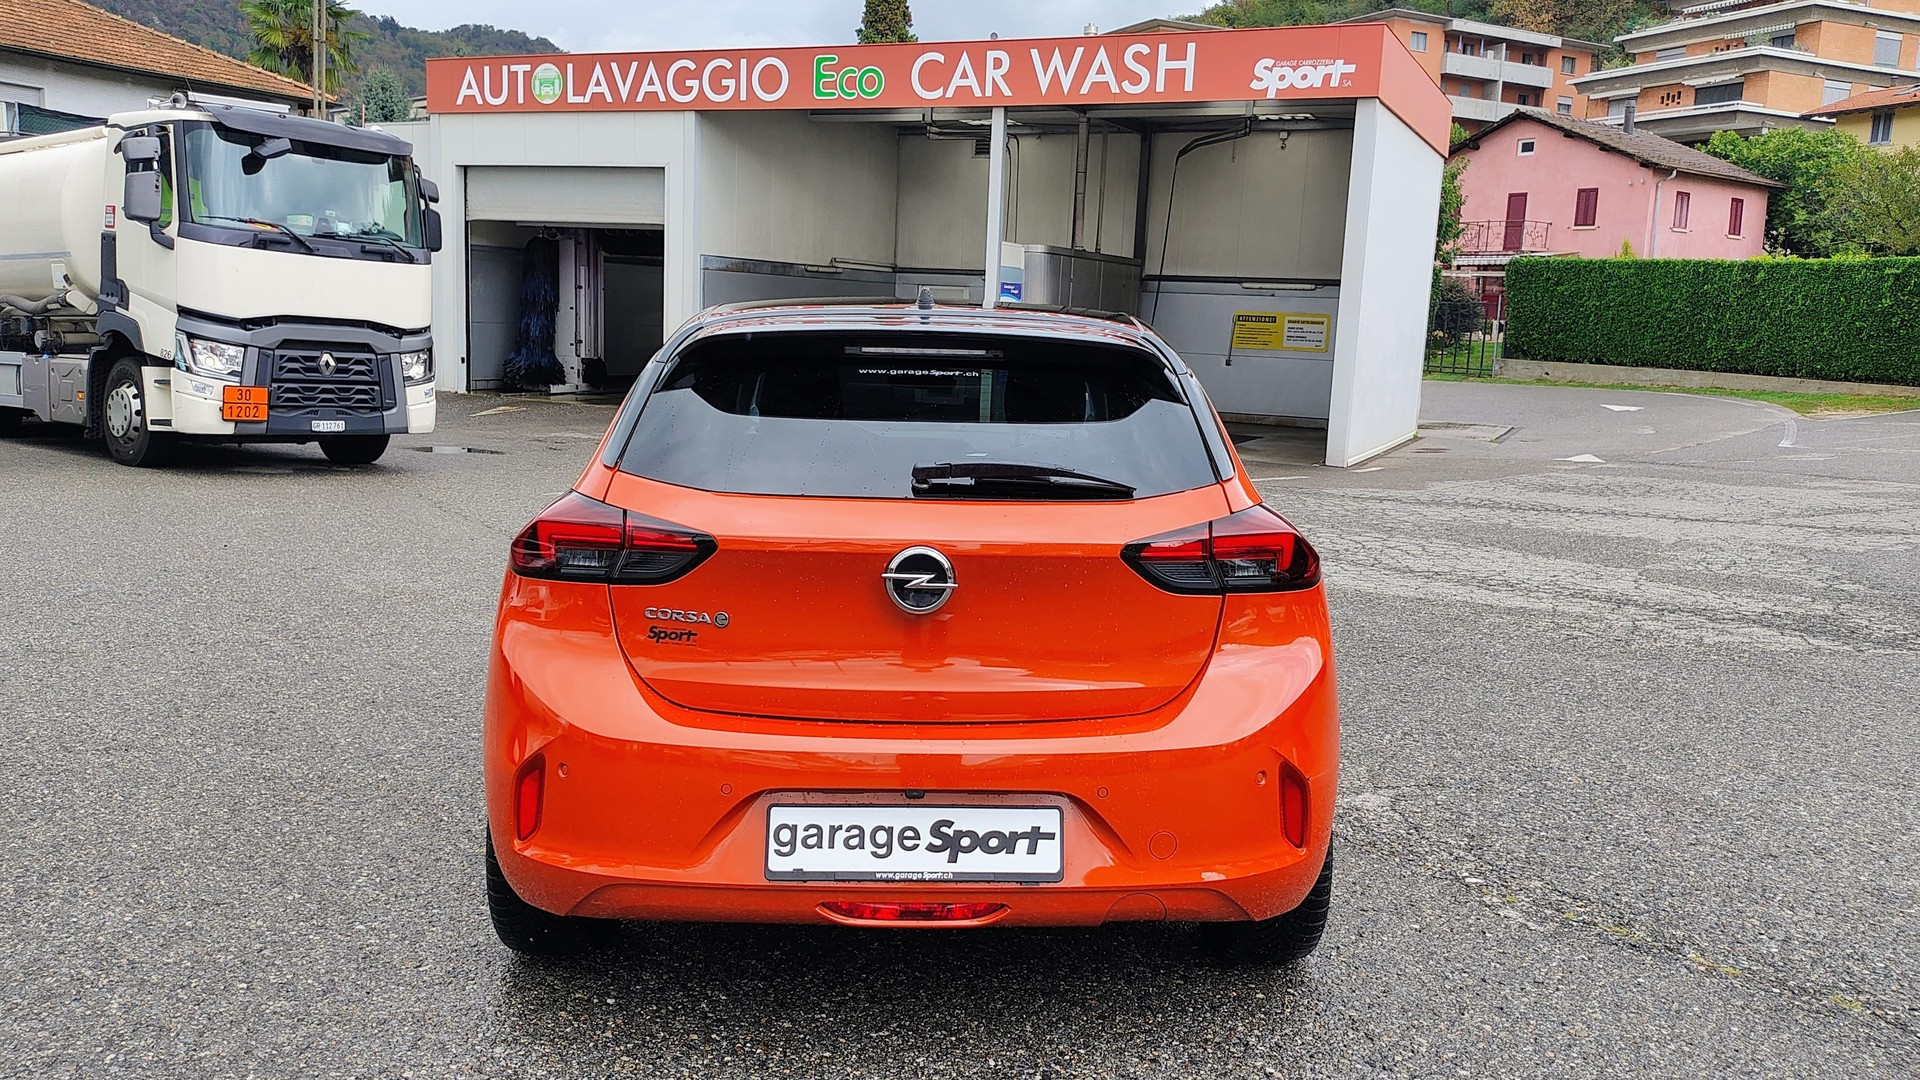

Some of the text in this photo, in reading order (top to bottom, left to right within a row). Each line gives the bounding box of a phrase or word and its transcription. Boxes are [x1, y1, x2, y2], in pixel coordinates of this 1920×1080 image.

[813, 55, 885, 100] Eco
[910, 50, 1013, 100] CAR
[1029, 42, 1196, 96] WASH
[1249, 58, 1356, 99] Sport
[1342, 79, 1352, 87] SA
[160, 348, 172, 359] 826
[236, 388, 251, 402] 30
[228, 404, 260, 418] 1202
[644, 607, 712, 624] CORSA
[646, 625, 698, 643] Sport
[875, 872, 953, 881] www.garageSport.ch
